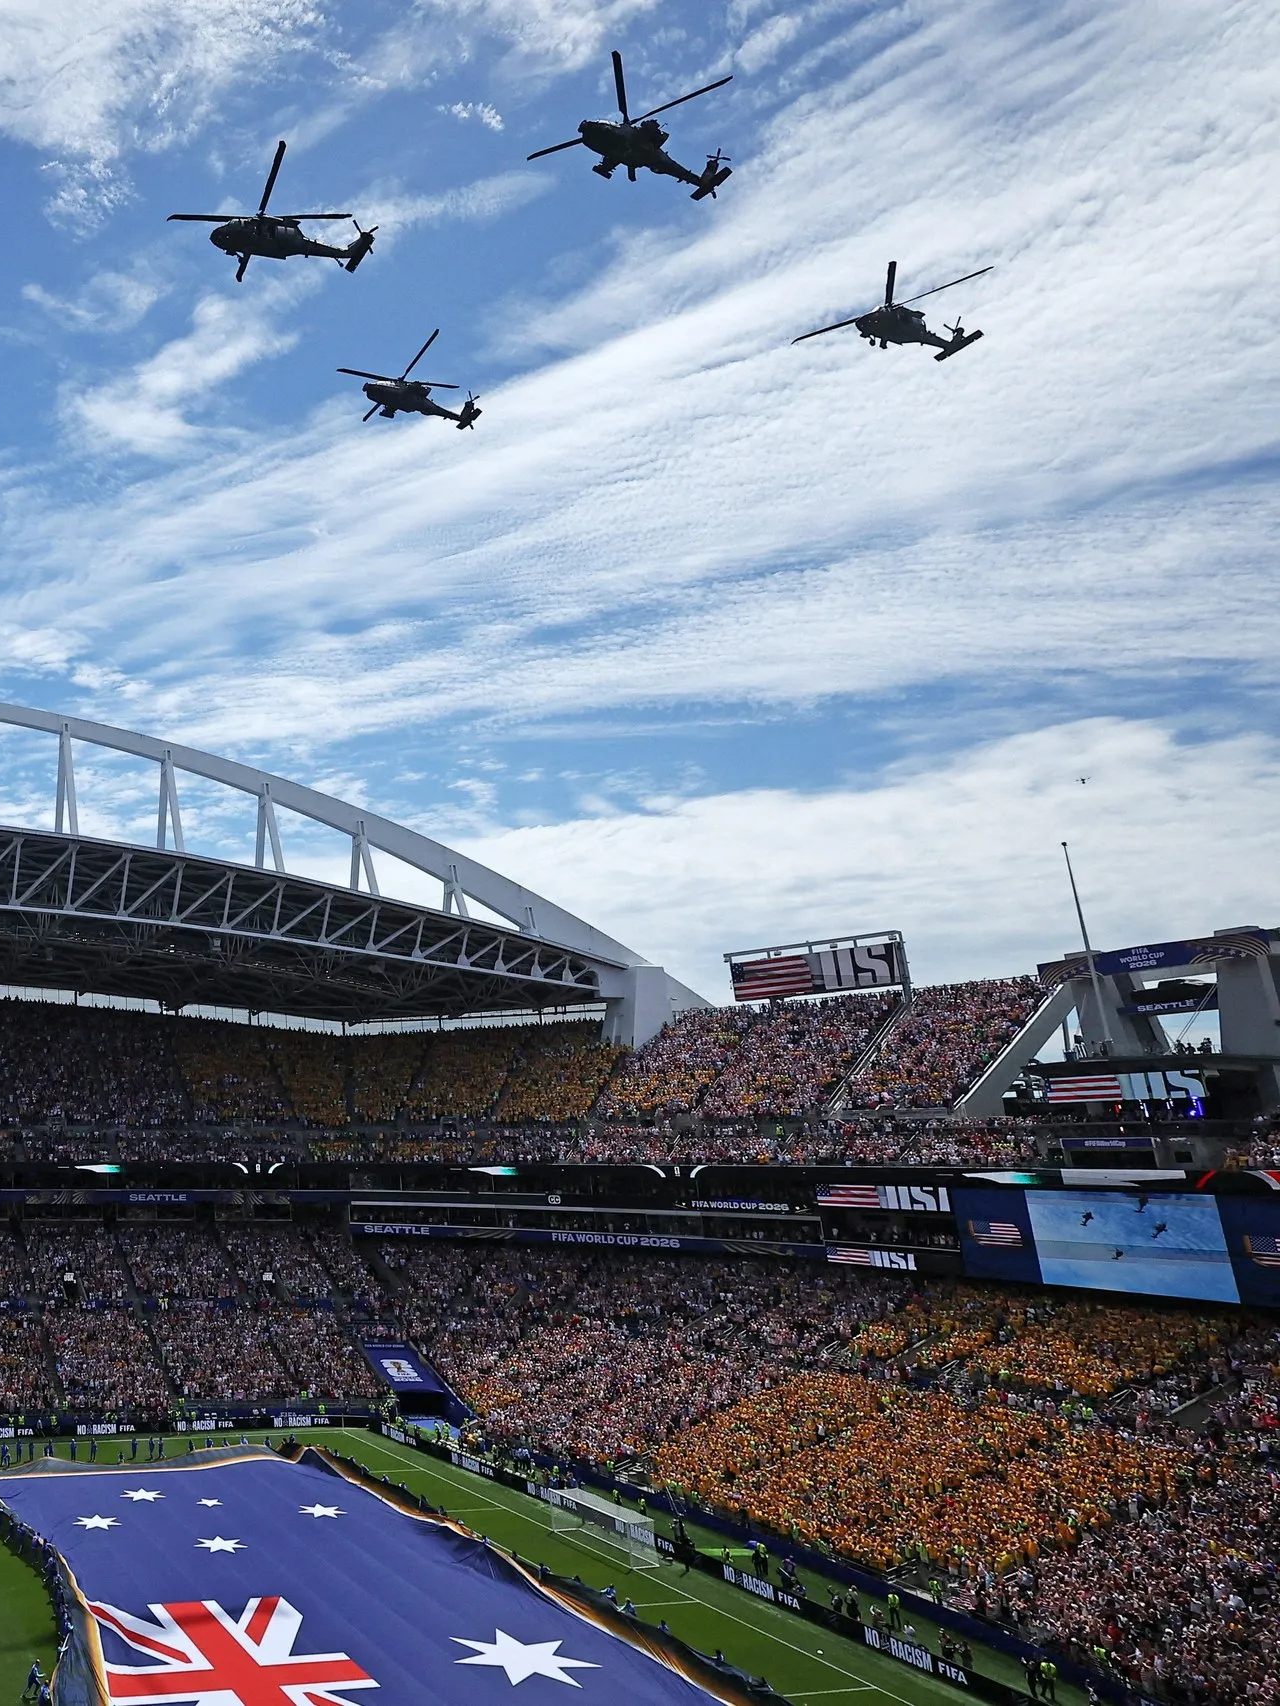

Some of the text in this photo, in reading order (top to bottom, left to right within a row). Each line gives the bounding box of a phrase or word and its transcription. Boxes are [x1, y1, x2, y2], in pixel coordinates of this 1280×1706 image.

[1131, 947, 1149, 955] FIFA
[1120, 951, 1165, 964] WORLD CUP
[1129, 959, 1157, 969] 2026
[1137, 999, 1195, 1012] SEATTLE
[692, 1200, 709, 1208] FIFA
[740, 1202, 757, 1210] CUP
[758, 1203, 790, 1211] 2026
[364, 1225, 430, 1235] SEATTLE
[552, 1233, 680, 1248] FIFA WORLD CUP 2026
[178, 1421, 186, 1431] NO
[192, 1420, 215, 1430] RACISM
[274, 1417, 282, 1428] NO
[288, 1416, 311, 1427] RACISM
[17, 1428, 34, 1436] FIFA
[77, 1424, 136, 1435] NO RACISM FIFA
[406, 1436, 416, 1446] FIFA
[481, 1466, 494, 1476] FIFA
[563, 1498, 577, 1511] FIFA
[657, 1538, 675, 1554] FIFA
[723, 1564, 800, 1610] NO RACISM FIFA
[864, 1626, 969, 1686] NO RACISM FIFA
